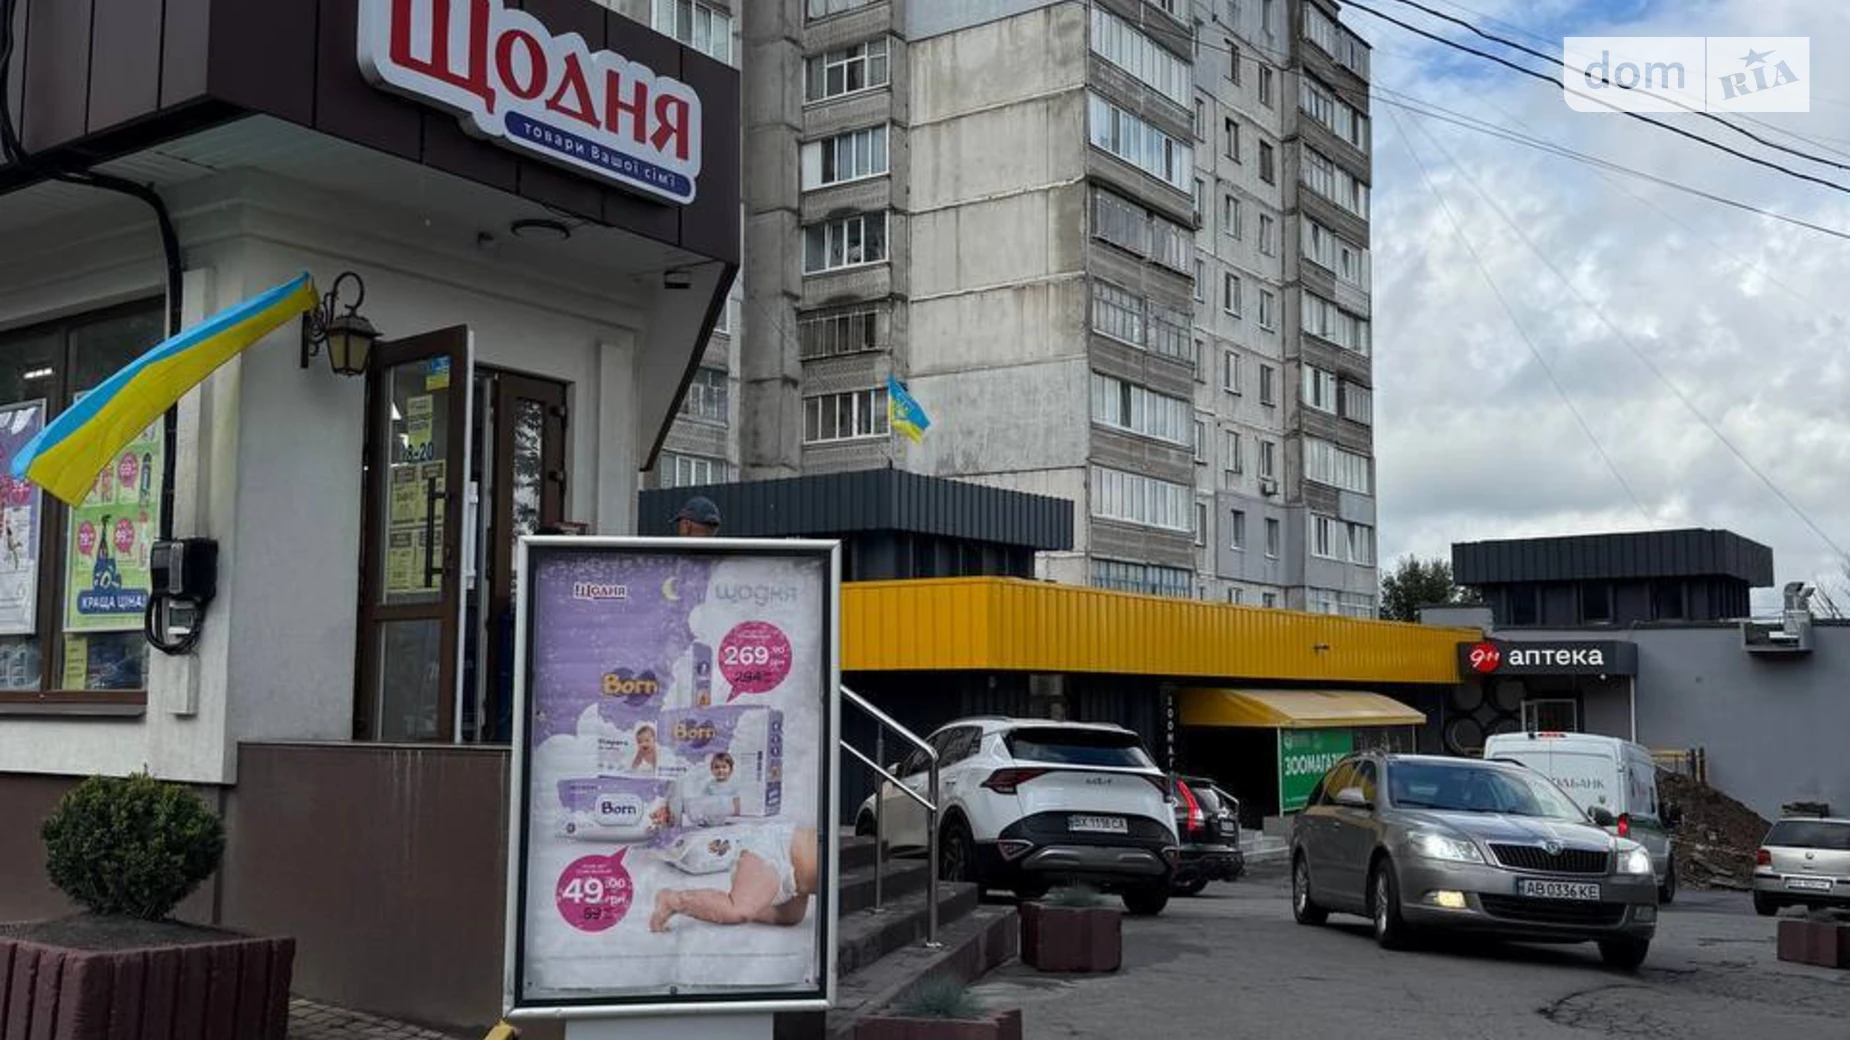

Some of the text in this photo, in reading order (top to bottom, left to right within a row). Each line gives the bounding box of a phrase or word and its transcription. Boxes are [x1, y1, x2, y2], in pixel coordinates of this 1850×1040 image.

[523, 123, 585, 154] товари
[591, 145, 639, 174] Вашої
[723, 645, 769, 667] 269
[1509, 649, 1604, 666] аптека
[603, 674, 659, 695] Born
[672, 724, 716, 740] Born
[602, 801, 637, 815] Born
[562, 877, 604, 904] 49
